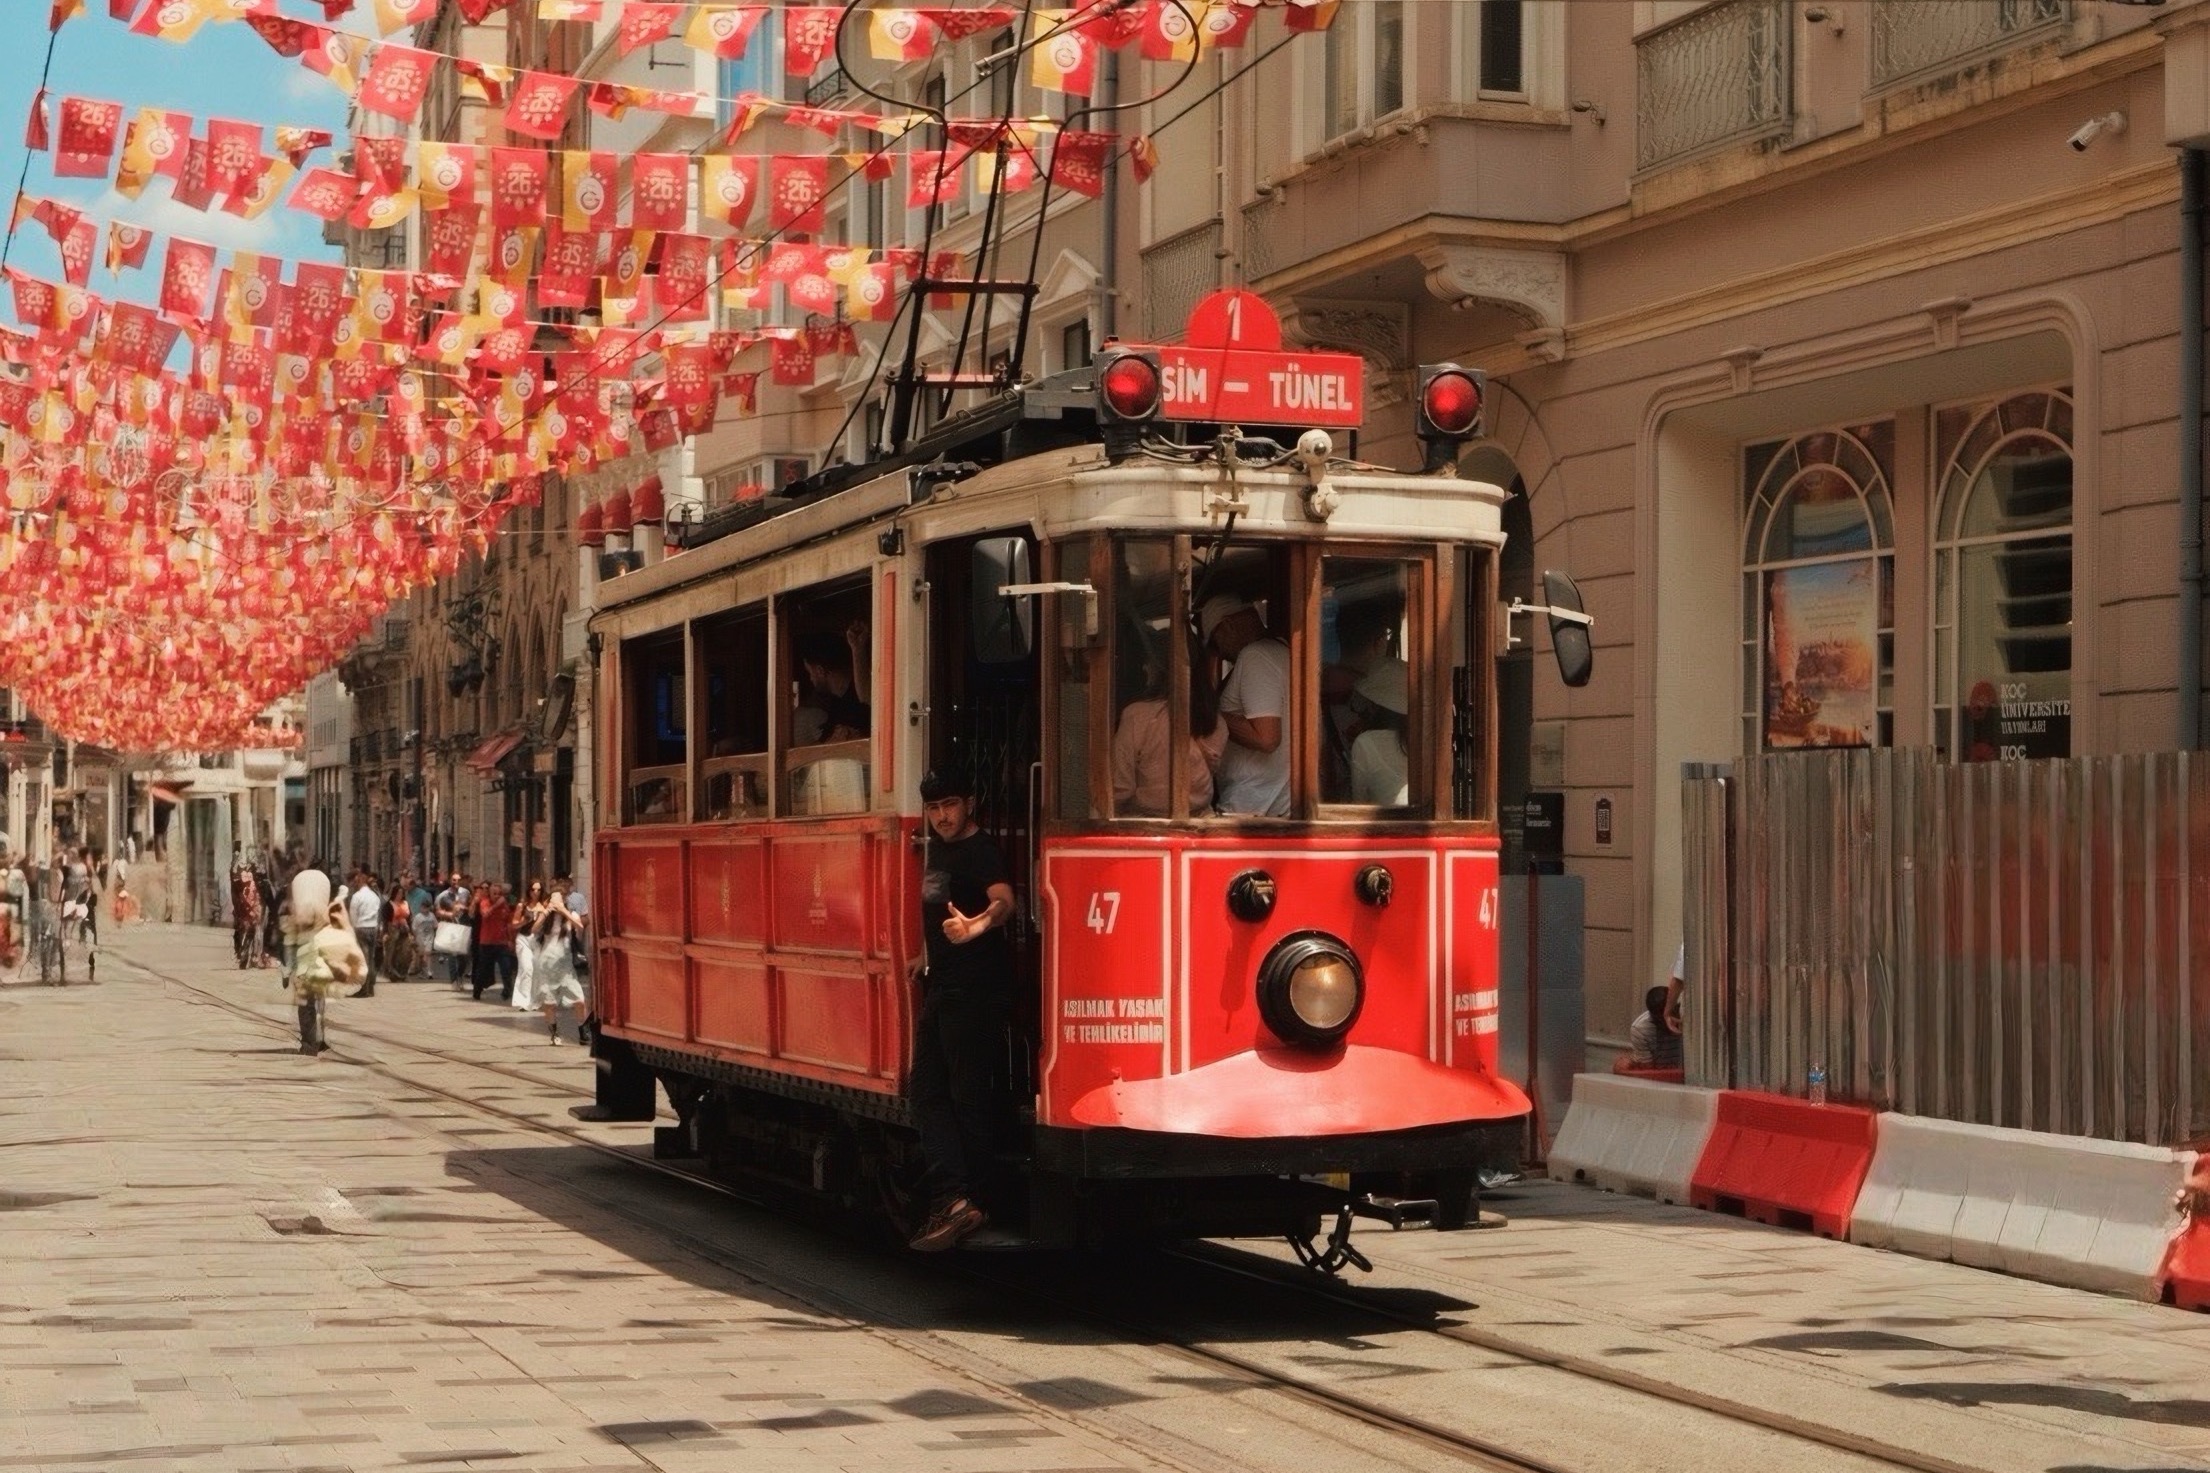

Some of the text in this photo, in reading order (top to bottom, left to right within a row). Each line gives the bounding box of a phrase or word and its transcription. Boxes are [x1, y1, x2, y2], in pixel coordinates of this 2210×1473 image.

[222, 143, 246, 168] 26
[508, 173, 531, 194] 26
[649, 177, 674, 200] 26
[787, 179, 812, 202] 26
[308, 289, 330, 310] 26
[1226, 297, 1242, 342] 1
[1269, 362, 1354, 412] TÜNEL
[1086, 891, 1121, 935] 47
